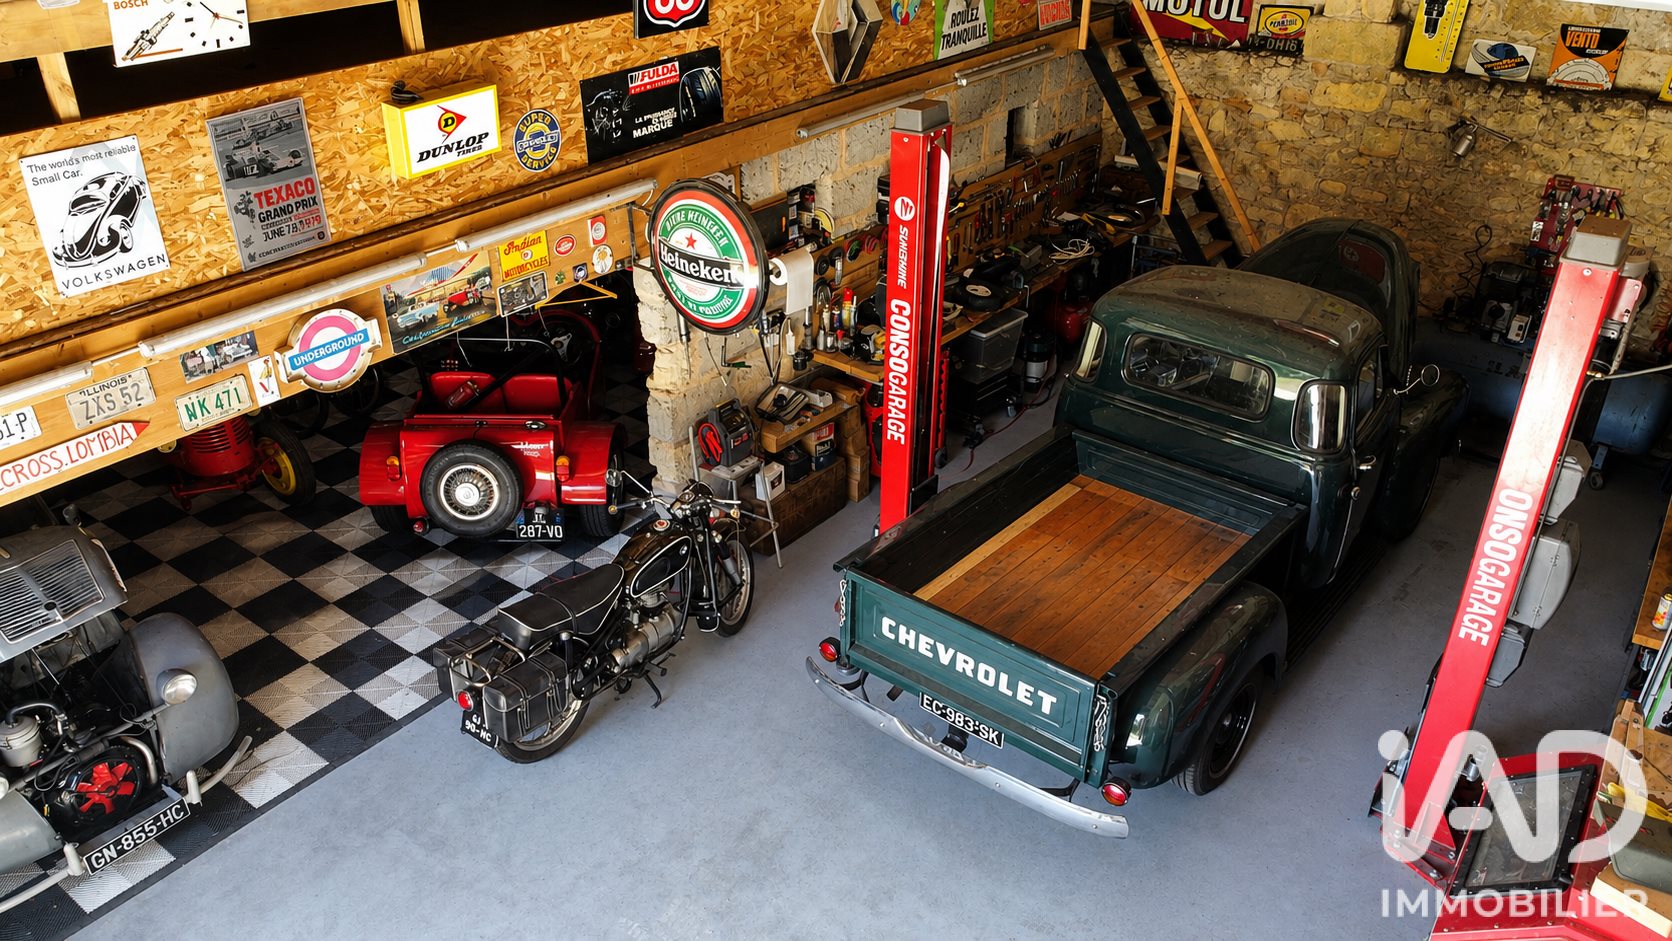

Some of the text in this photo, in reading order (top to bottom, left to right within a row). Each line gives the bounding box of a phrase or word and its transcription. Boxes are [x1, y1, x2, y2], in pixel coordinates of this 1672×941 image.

[114, 0, 149, 10] BOSCH
[950, 6, 980, 30] ROULEZ
[941, 22, 988, 51] TRANQUILLE
[640, 63, 678, 82] FULDA
[443, 116, 456, 129] D
[632, 120, 673, 138] MARQUE
[27, 164, 47, 174] The
[81, 152, 103, 163] most
[104, 143, 136, 158] reliable
[416, 132, 489, 163] DUNLOP
[31, 168, 84, 187] Small Car.
[253, 177, 316, 209] TEXACO
[258, 203, 294, 223] GRAND
[295, 195, 318, 212] PRIX
[262, 225, 286, 242] JUNE
[503, 235, 542, 256] Indian
[62, 253, 167, 290] VOLKSWAGEN
[660, 242, 742, 285] Heineken
[293, 332, 365, 367] UNDERGROUND
[81, 376, 128, 396] ILLINOIS
[886, 299, 911, 445] CONSOGARAGE
[79, 382, 145, 421] ZXS 52
[184, 397, 211, 423] NK
[214, 387, 242, 411] 471
[1457, 486, 1534, 647] ONSOGARAGE
[880, 615, 1058, 716] CHEVROLET
[921, 694, 1000, 745] EC-983-SK
[91, 804, 185, 870] GN-855-HC
